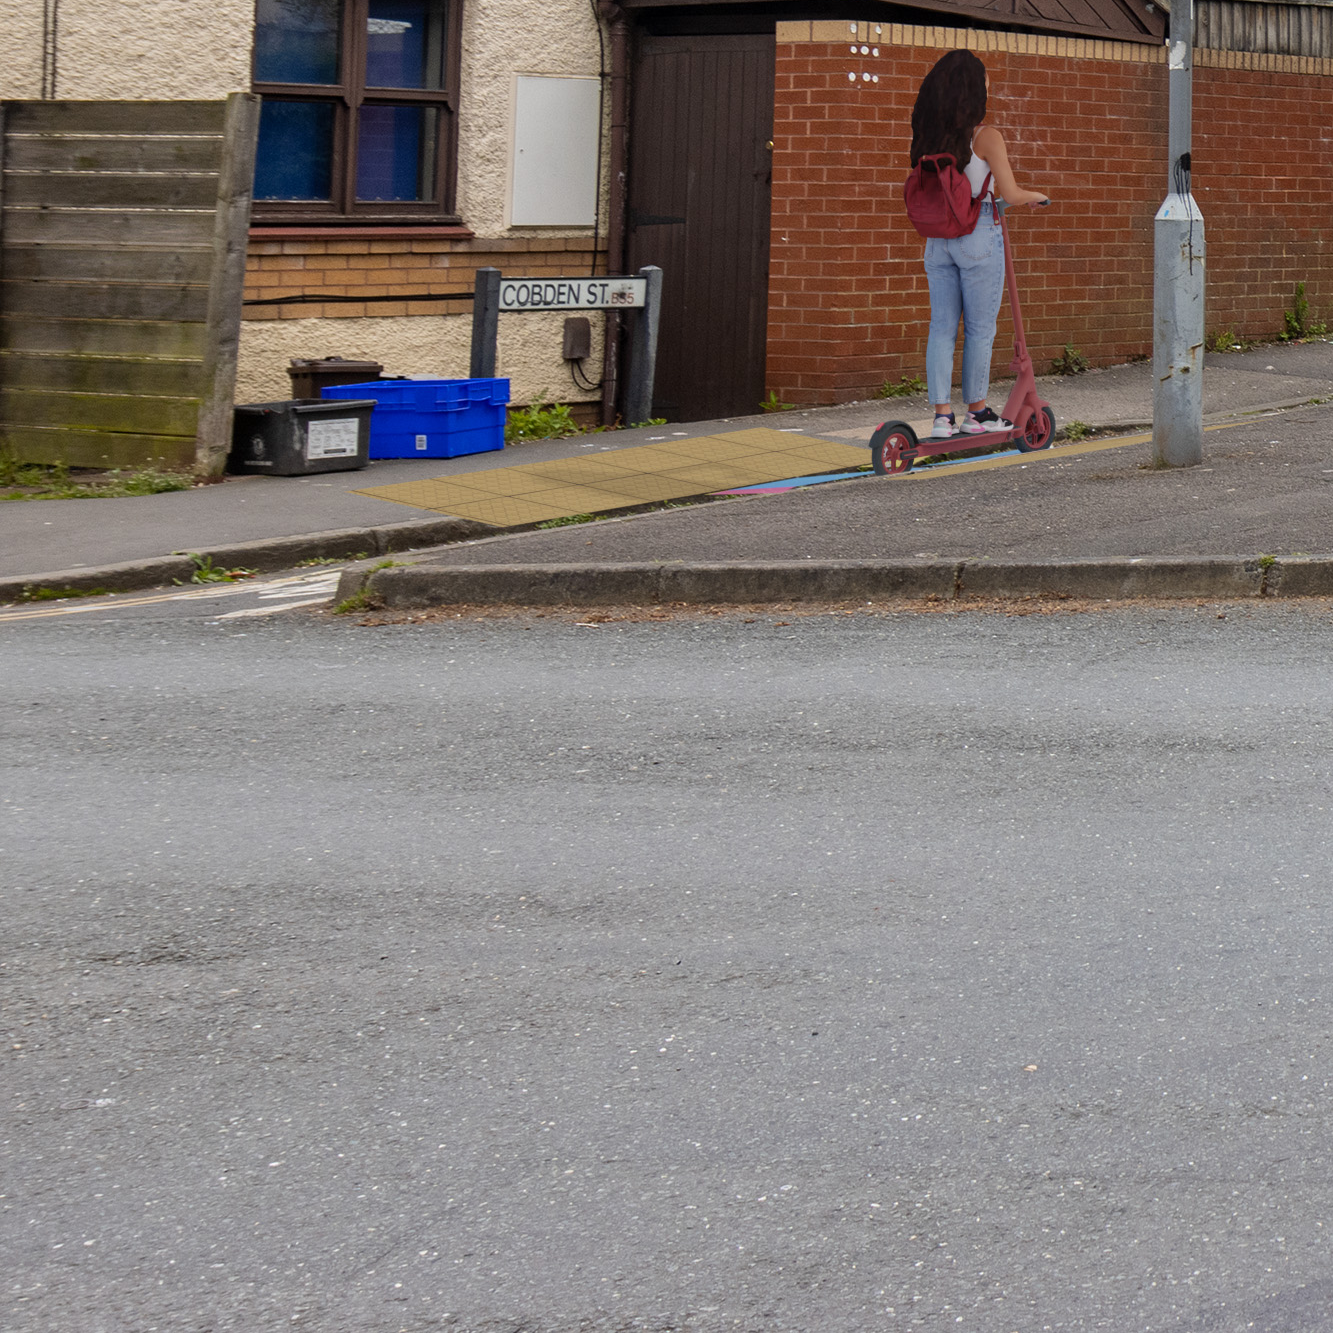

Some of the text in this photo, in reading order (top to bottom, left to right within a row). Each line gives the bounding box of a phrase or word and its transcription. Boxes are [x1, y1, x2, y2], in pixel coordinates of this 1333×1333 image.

[502, 283, 609, 307] COBDEN ST.
[611, 292, 635, 304] BS5
